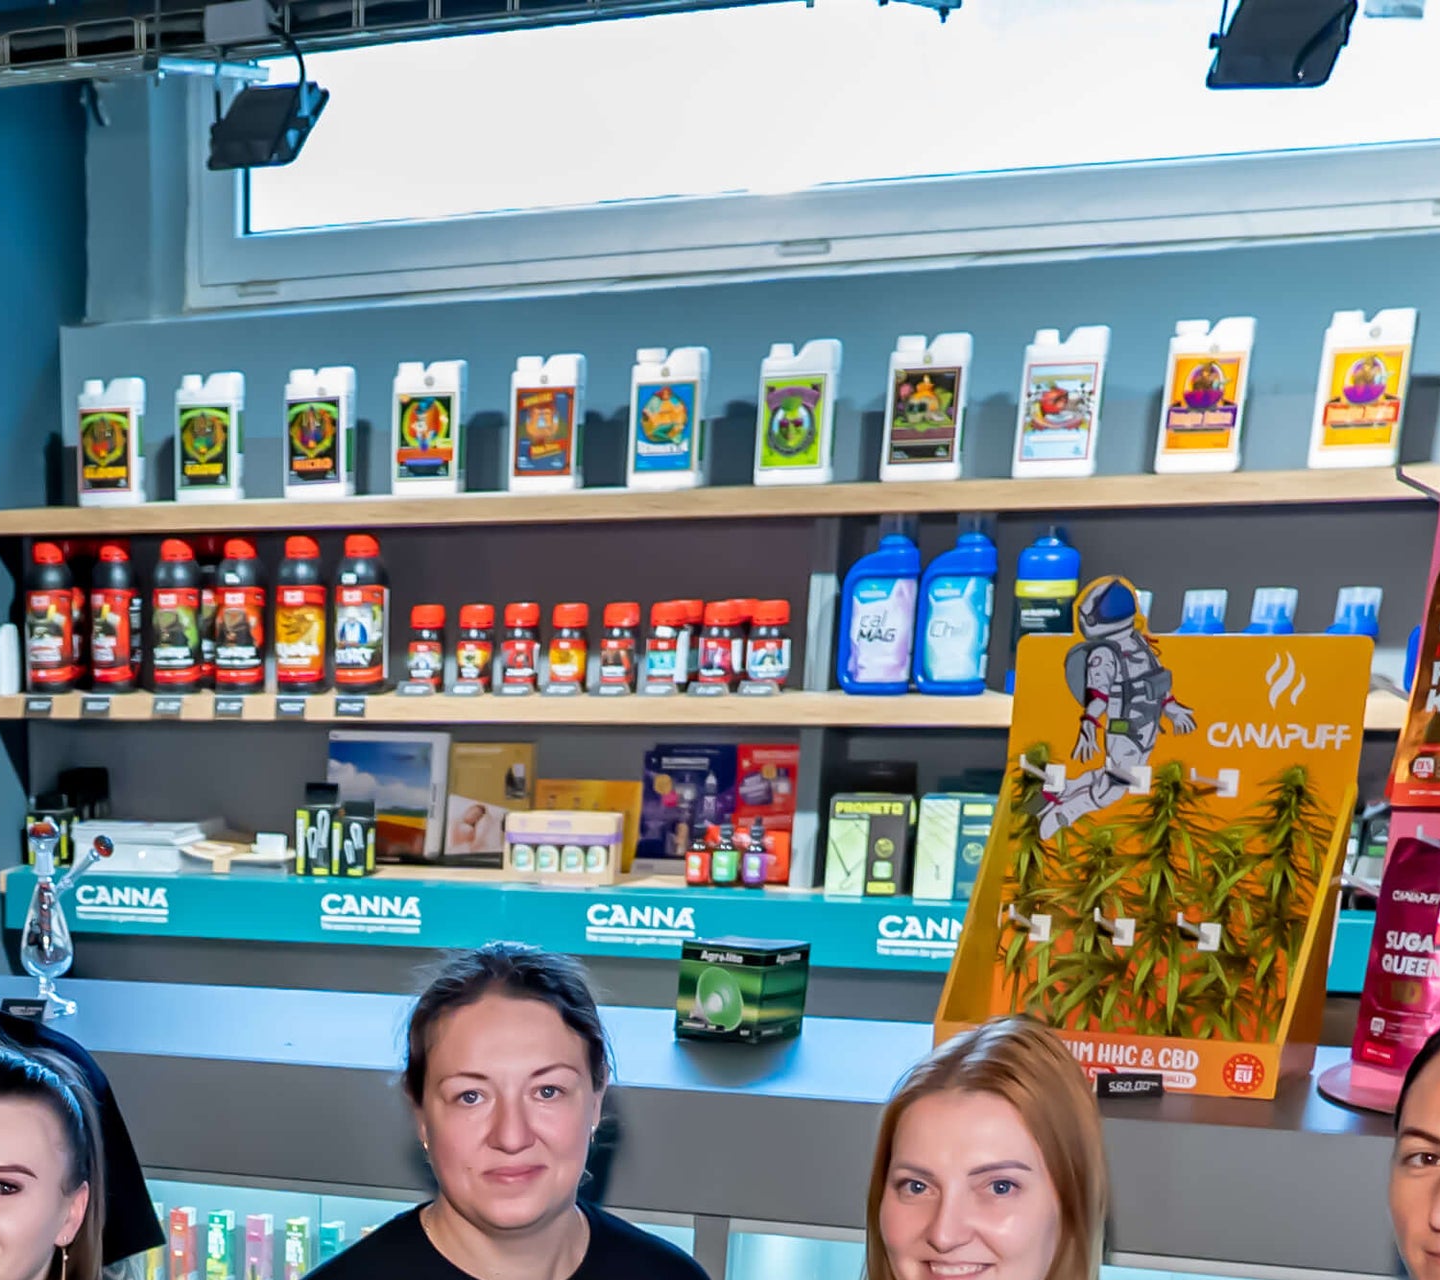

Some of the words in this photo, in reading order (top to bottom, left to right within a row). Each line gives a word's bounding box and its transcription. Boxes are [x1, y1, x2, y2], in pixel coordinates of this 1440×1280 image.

[857, 628, 896, 642] MAG
[1207, 722, 1351, 750] CANAPUFF
[75, 885, 169, 908] CANNA
[320, 894, 421, 918] CANNA
[586, 903, 696, 929] CANNA
[1384, 931, 1439, 952] SUGA
[1097, 1043, 1137, 1064] HHC
[1141, 1049, 1155, 1067] &
[1158, 1048, 1199, 1070] CBD
